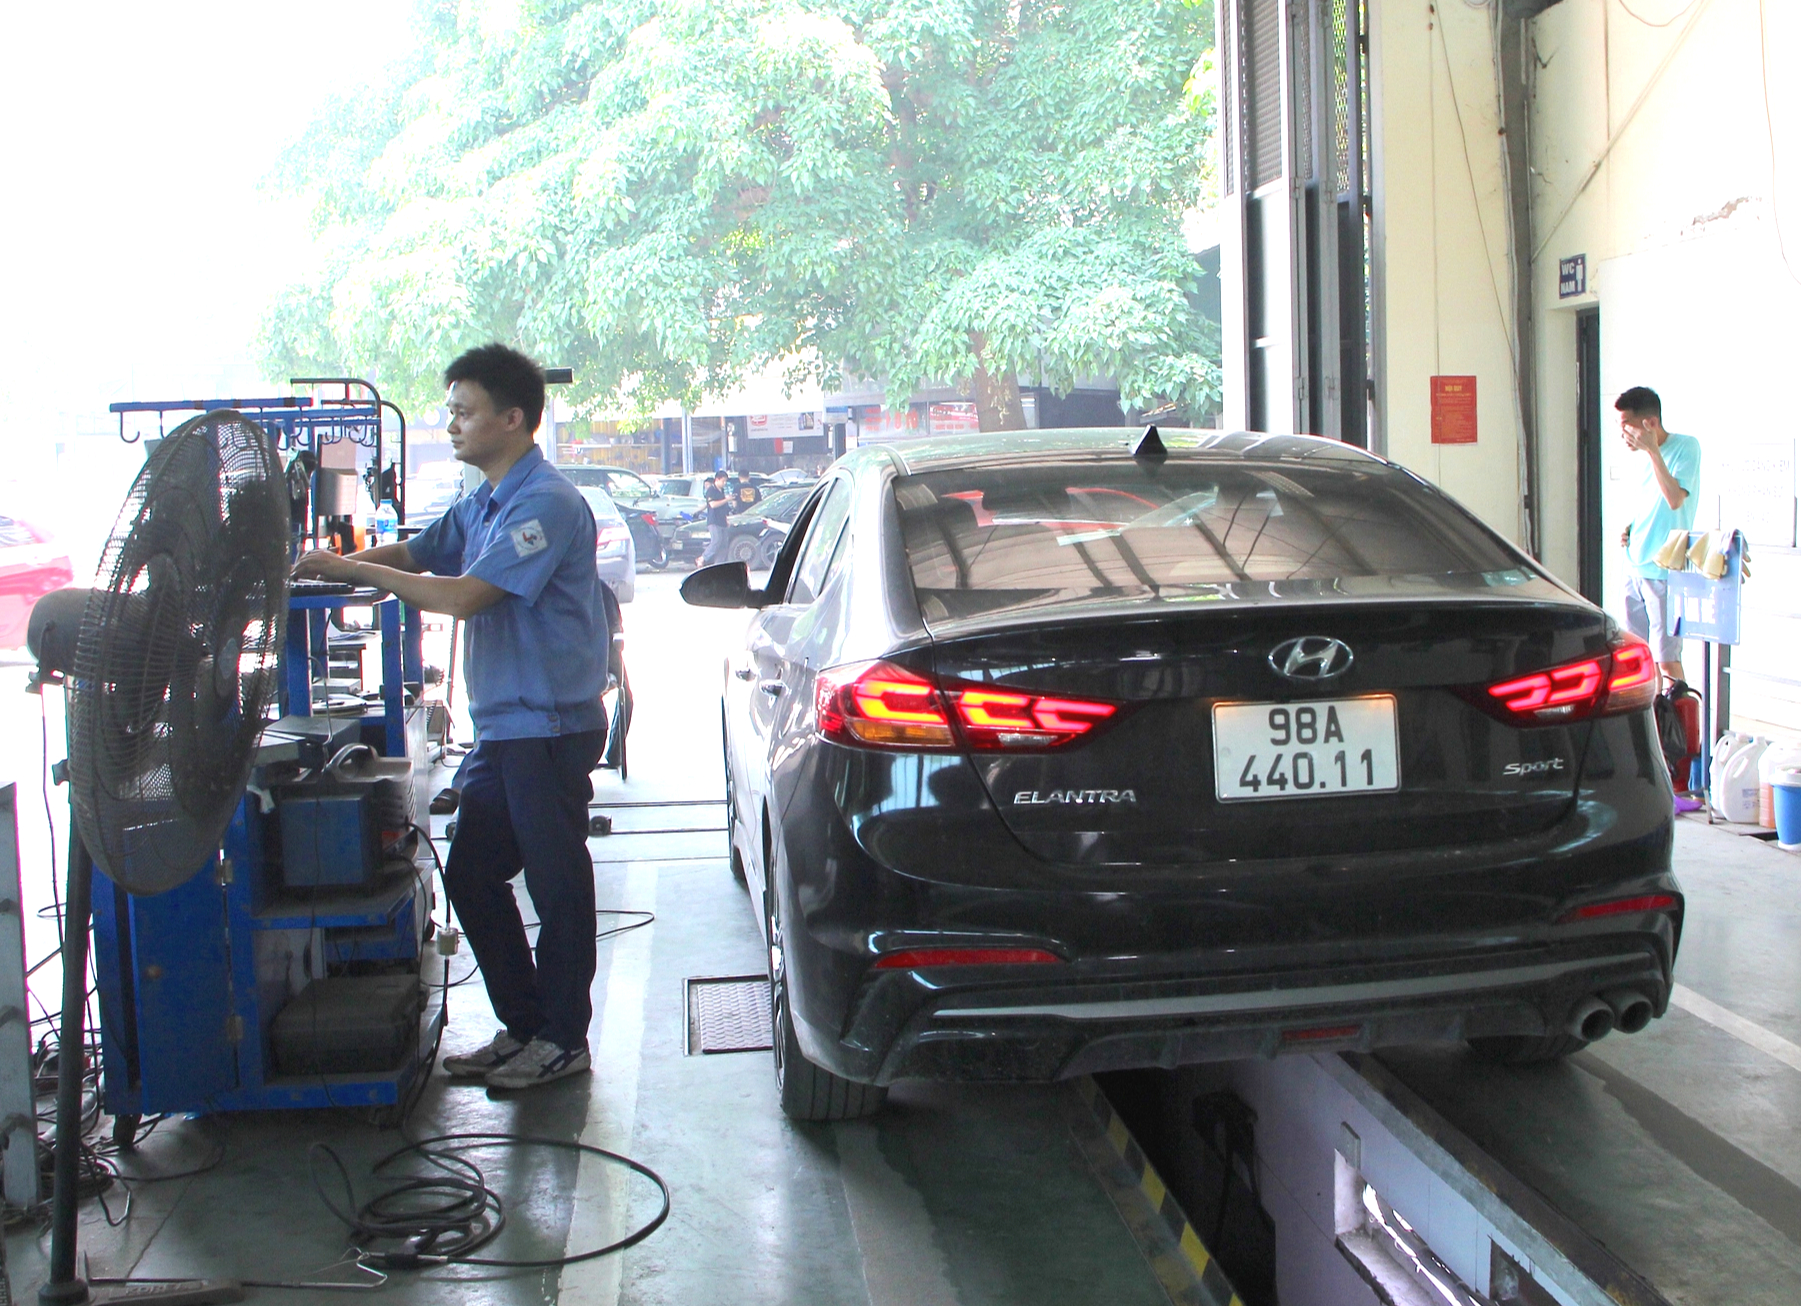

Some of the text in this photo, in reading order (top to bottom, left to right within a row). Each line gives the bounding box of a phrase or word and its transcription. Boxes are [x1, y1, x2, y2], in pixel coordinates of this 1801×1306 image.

[1561, 262, 1575, 276] WC
[1560, 280, 1576, 295] NAM
[1268, 705, 1344, 747] 98A
[1239, 748, 1374, 793] 440.11
[1503, 757, 1564, 777] Sport
[1013, 789, 1137, 805] ELANTRA
